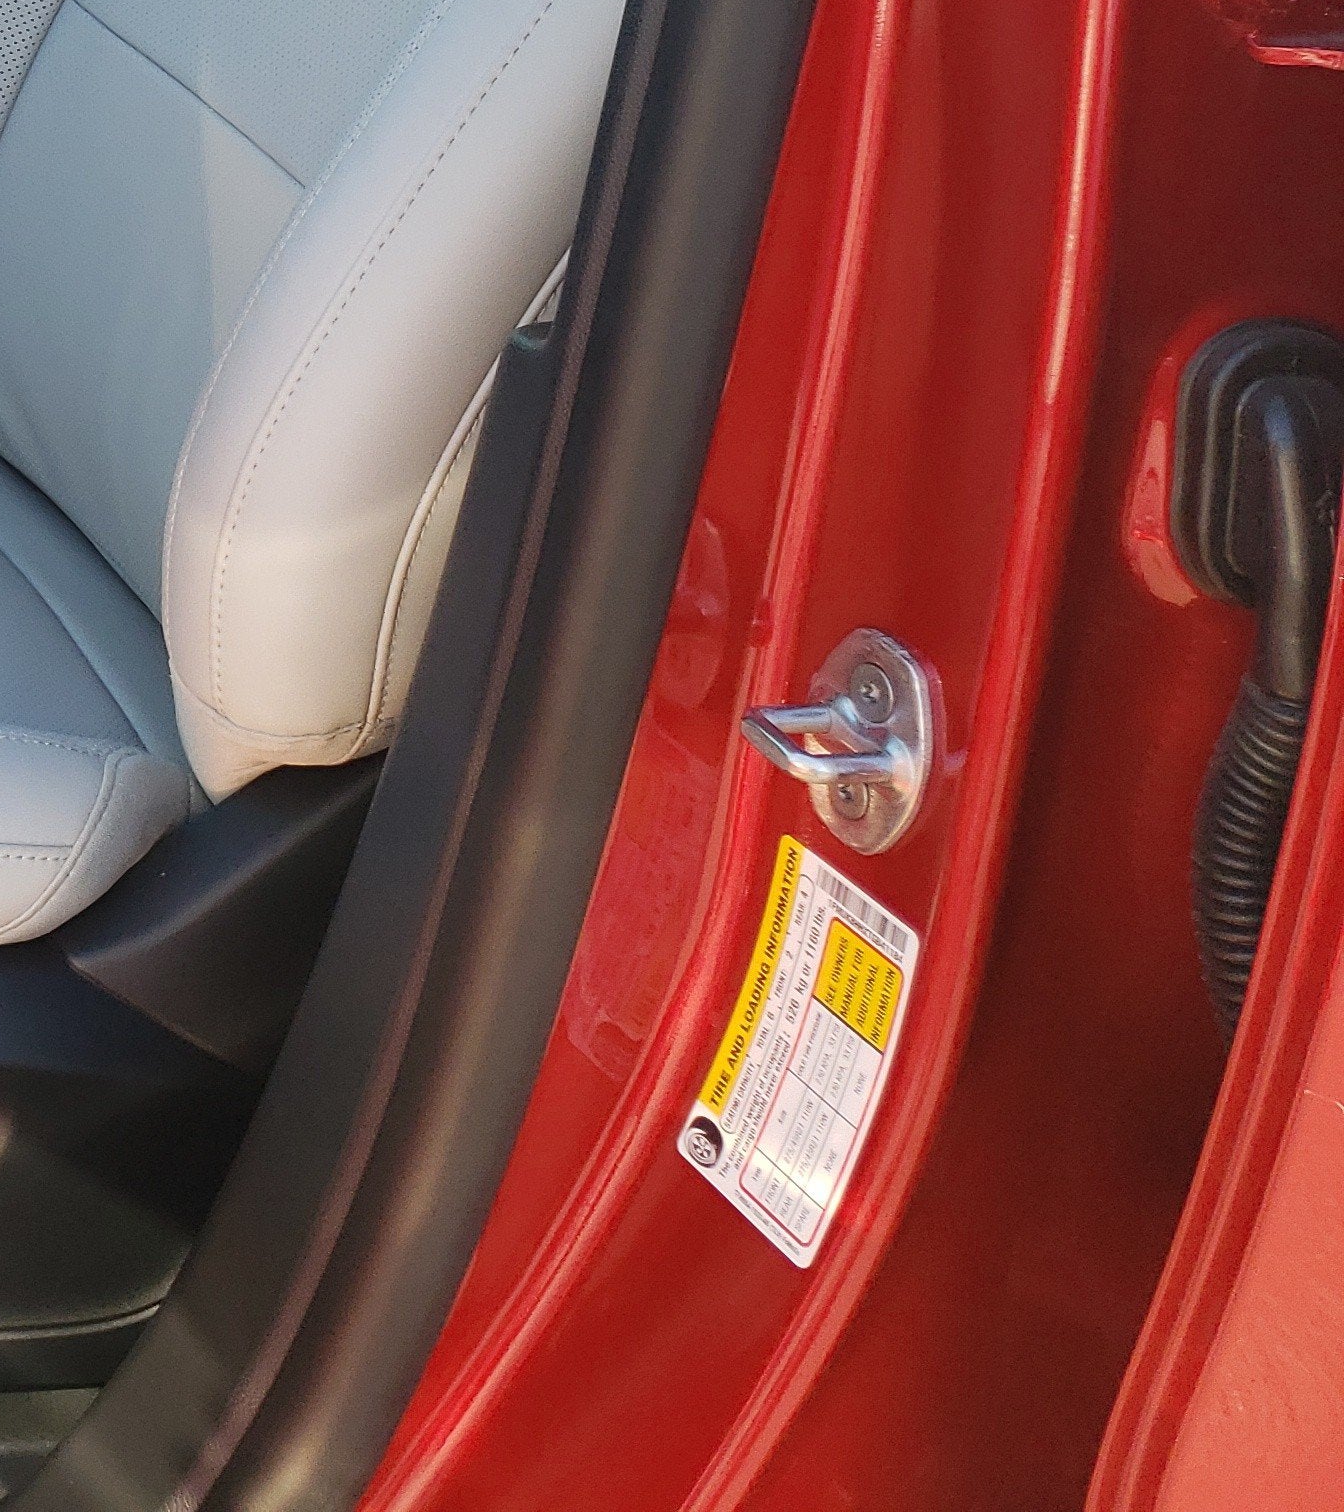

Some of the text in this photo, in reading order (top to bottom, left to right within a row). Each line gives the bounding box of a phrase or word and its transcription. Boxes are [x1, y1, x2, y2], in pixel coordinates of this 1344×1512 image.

[709, 846, 797, 1110] TIRE AND LOADING INFORMATION
[841, 972, 858, 1018] MANUAL
[870, 967, 896, 1043] INFORMATION
[745, 1089, 763, 1120] weight
